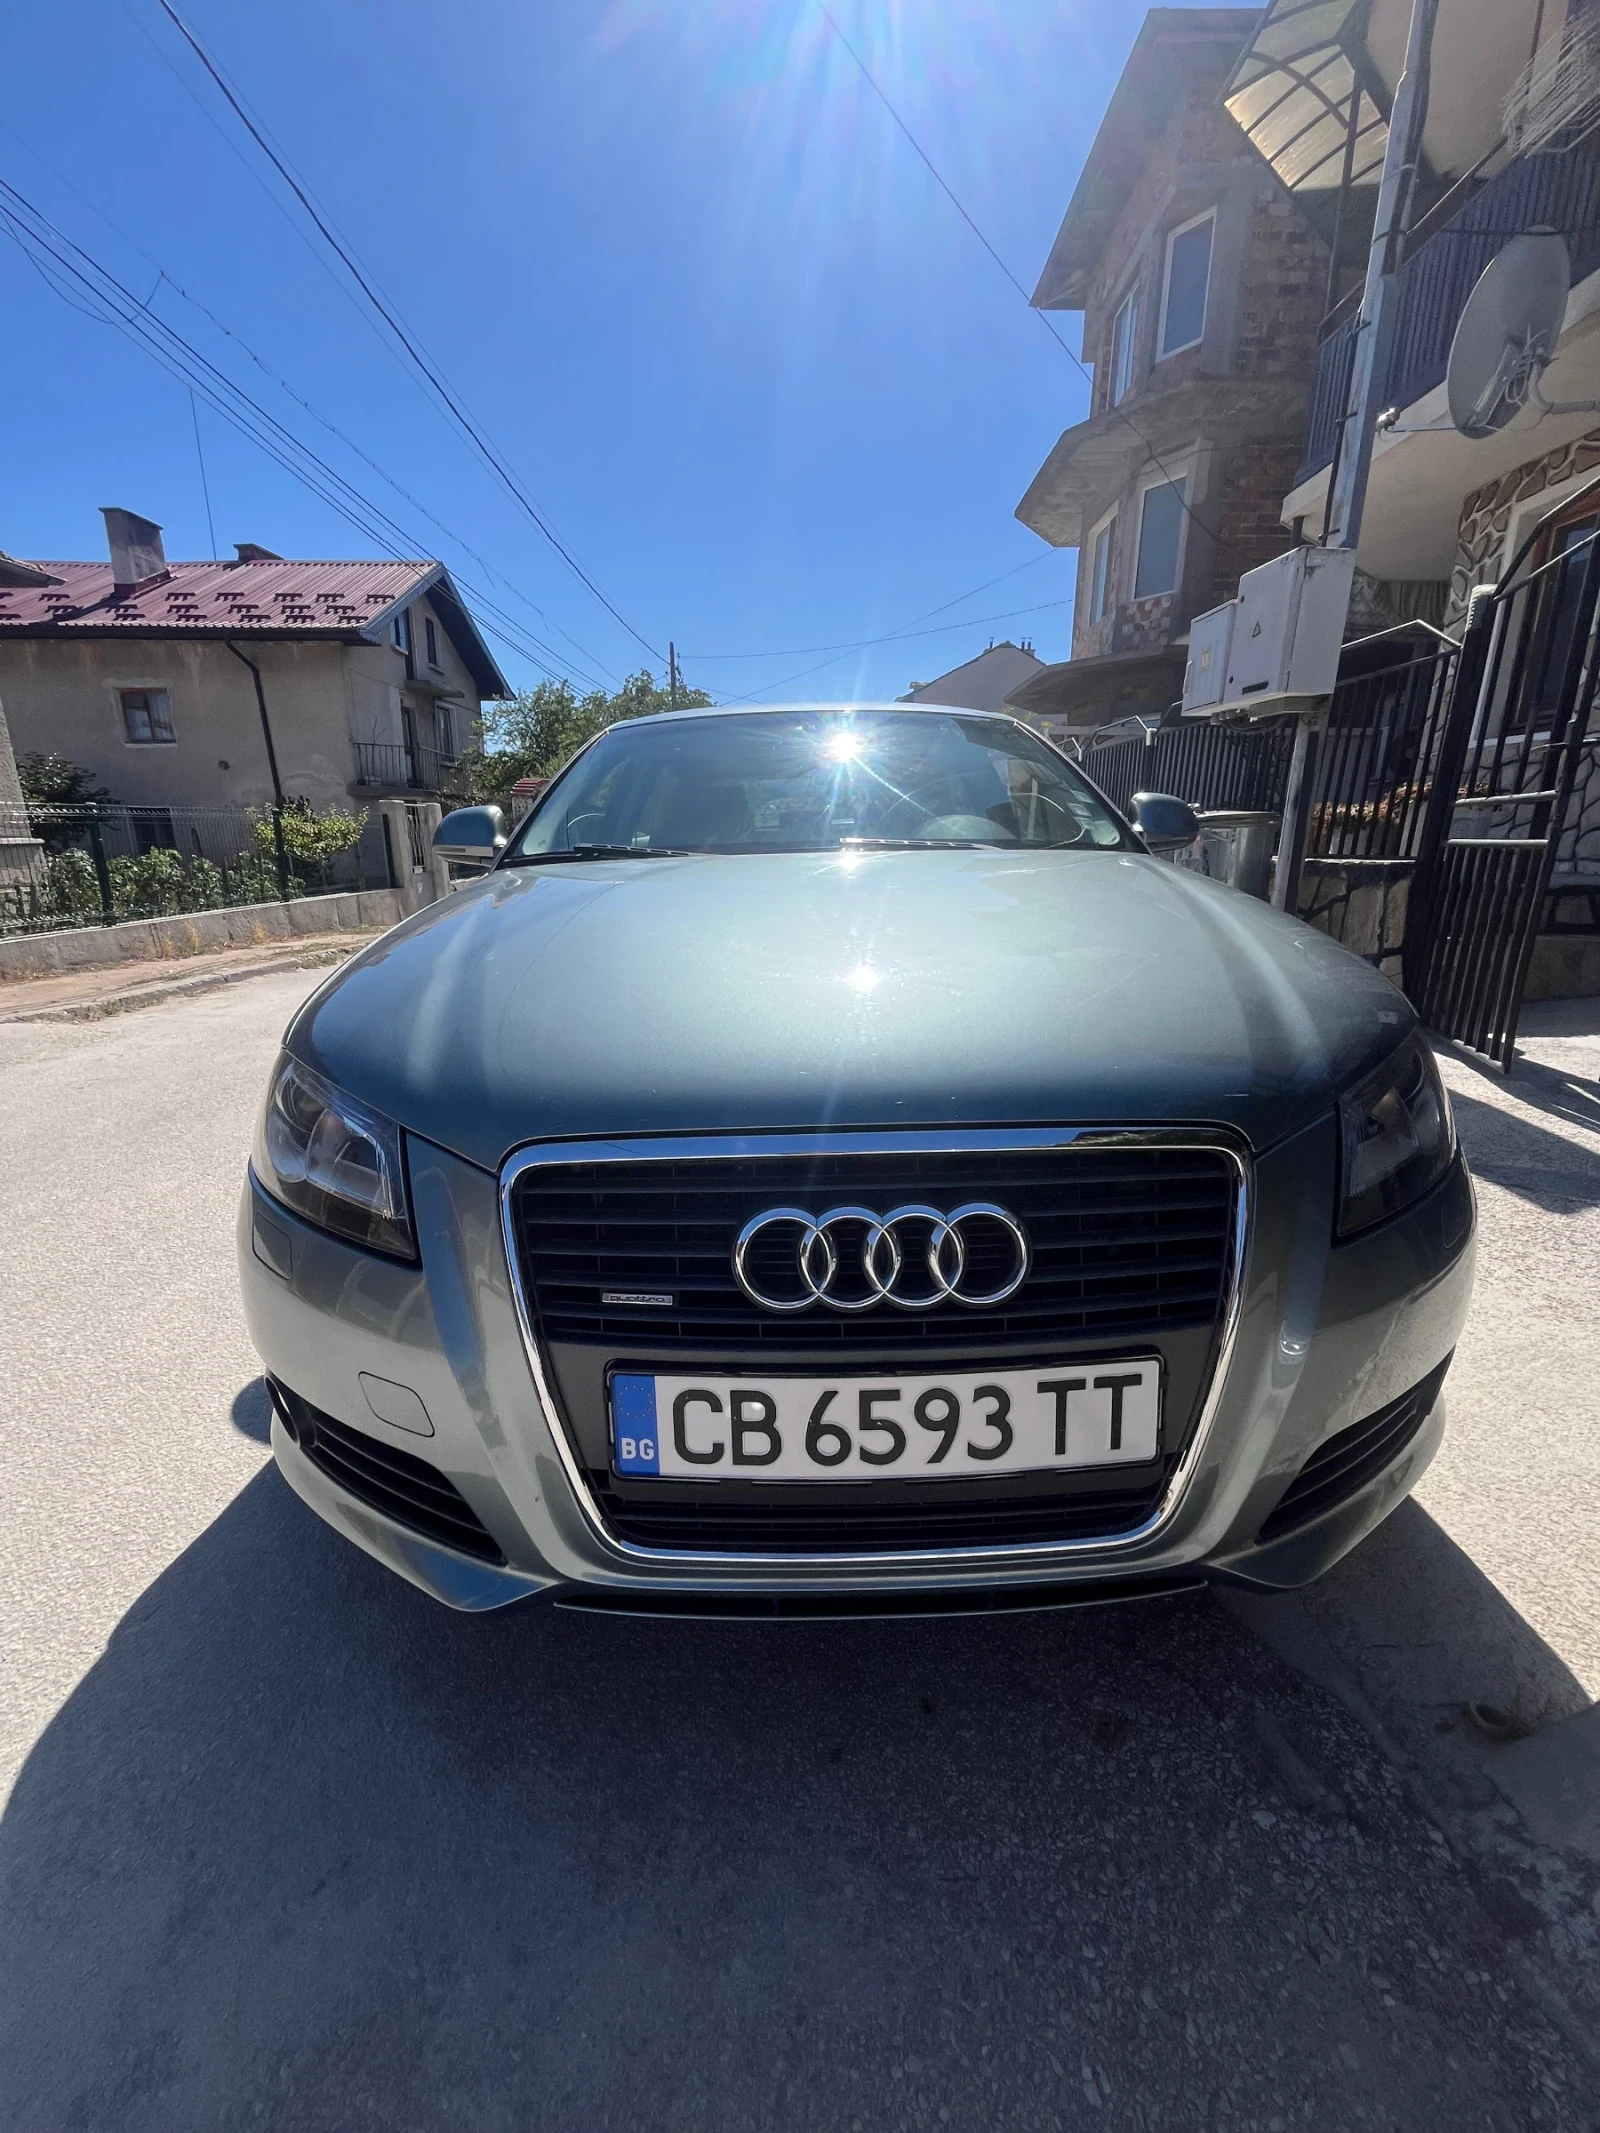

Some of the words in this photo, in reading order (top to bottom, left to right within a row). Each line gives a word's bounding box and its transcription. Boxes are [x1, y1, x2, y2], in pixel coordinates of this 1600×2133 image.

[607, 1294, 666, 1304] quattro
[672, 1388, 783, 1466] CB
[804, 1385, 1014, 1467] 6593
[1036, 1373, 1143, 1456] TT
[621, 1437, 655, 1460] BG
